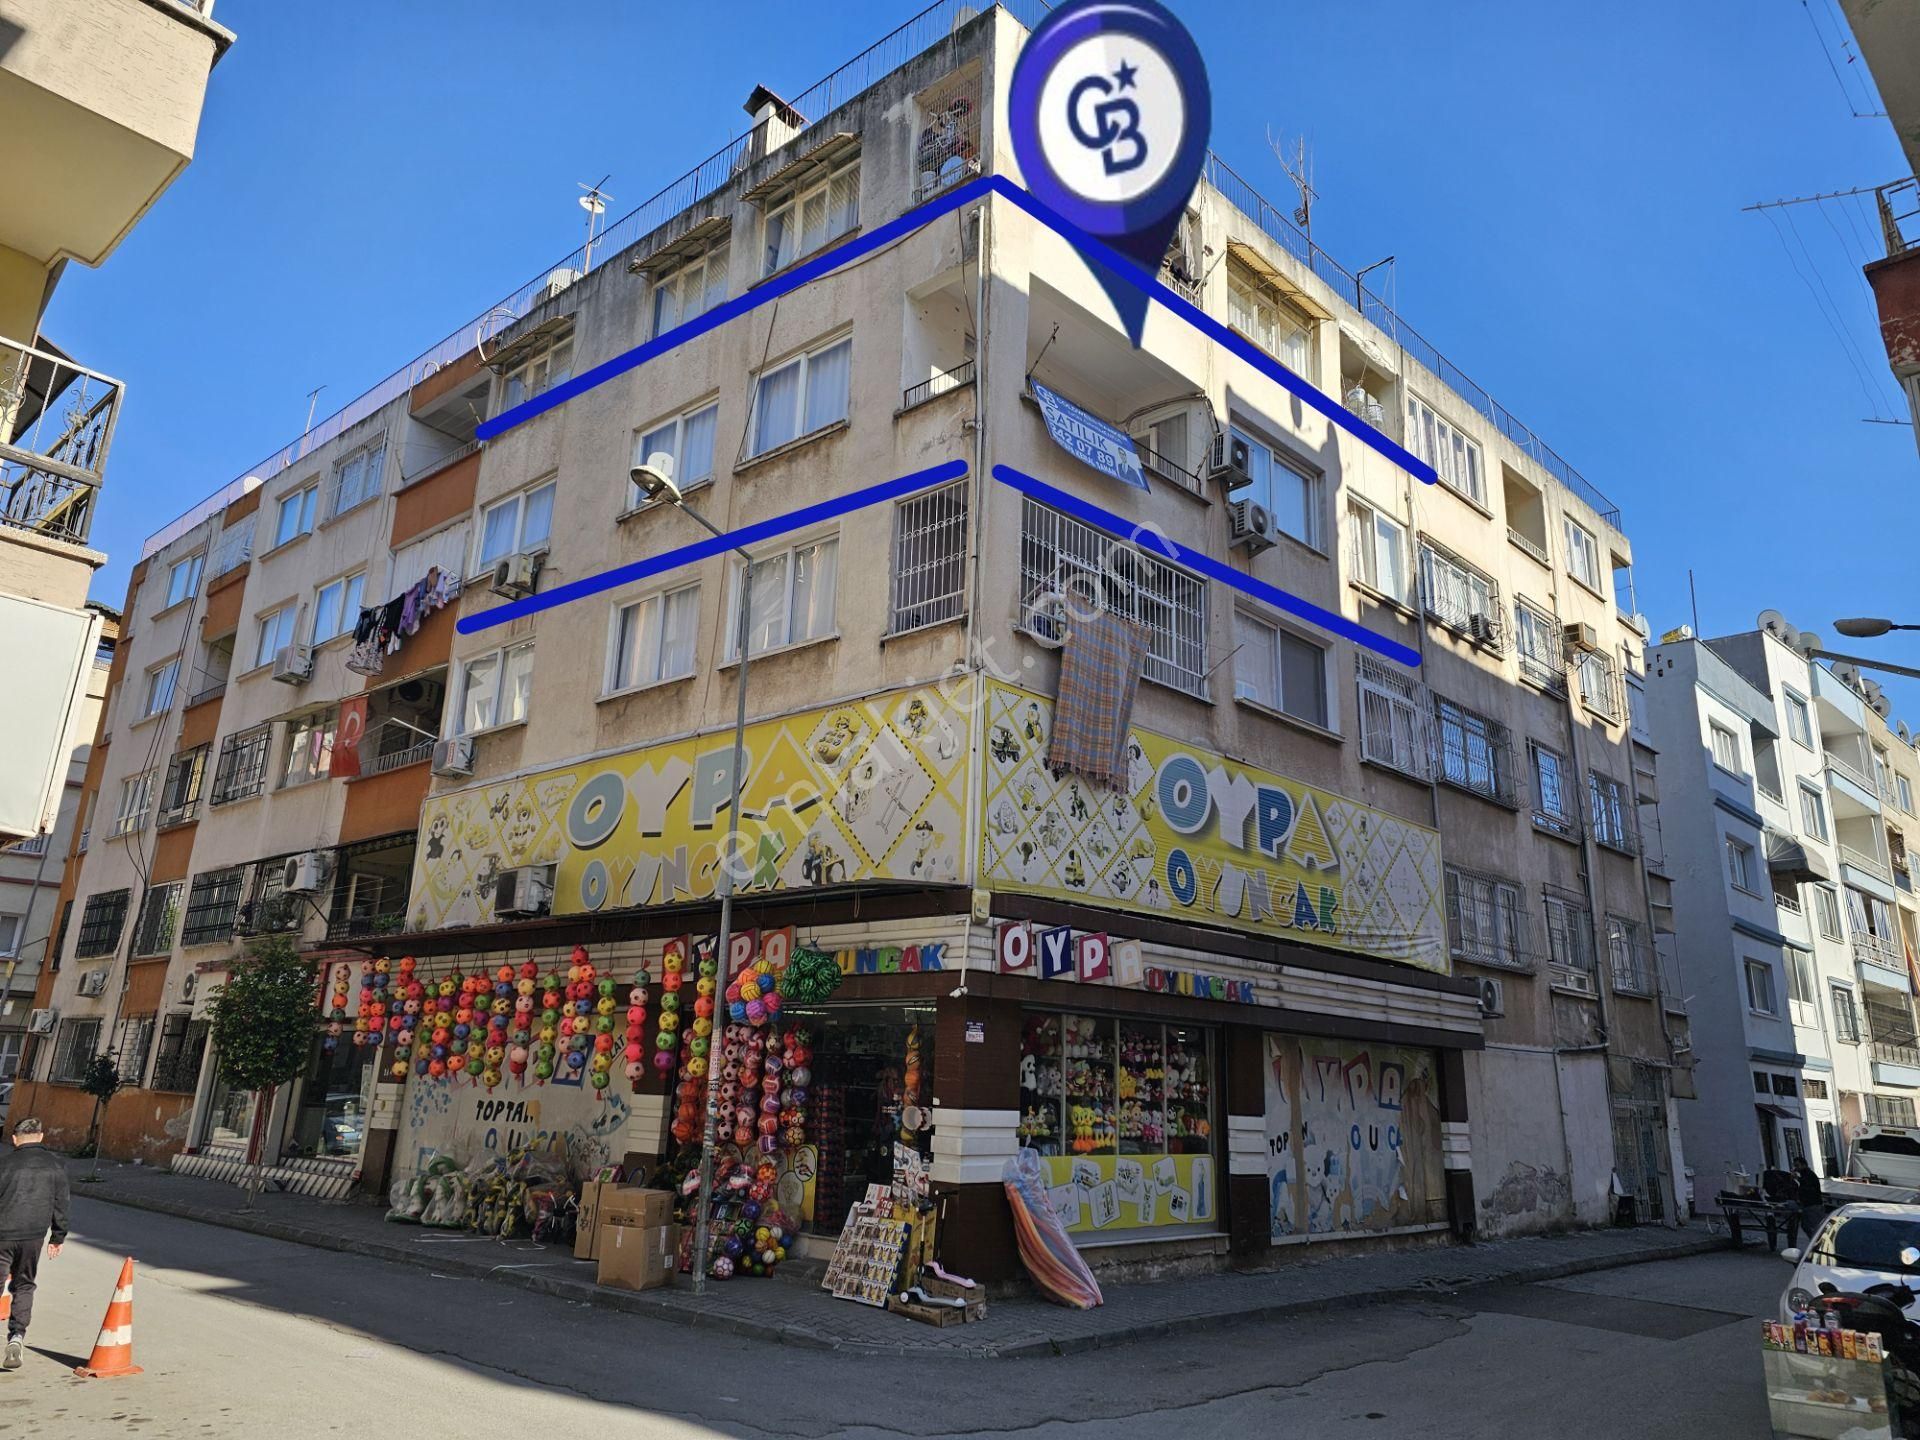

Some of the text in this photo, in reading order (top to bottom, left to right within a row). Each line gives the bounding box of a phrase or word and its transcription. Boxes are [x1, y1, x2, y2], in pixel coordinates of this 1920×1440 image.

[1045, 405, 1108, 451] SATILIK
[1076, 439, 1093, 456] 07
[1096, 451, 1114, 468] 89
[567, 725, 829, 850] OYPA
[1155, 753, 1340, 871] OYPA
[580, 831, 787, 912] OYUNCAK
[1166, 847, 1339, 936] OYUNCAK
[835, 943, 948, 974] UNCAK
[1003, 924, 1255, 1004] OYPA OYUNCAK
